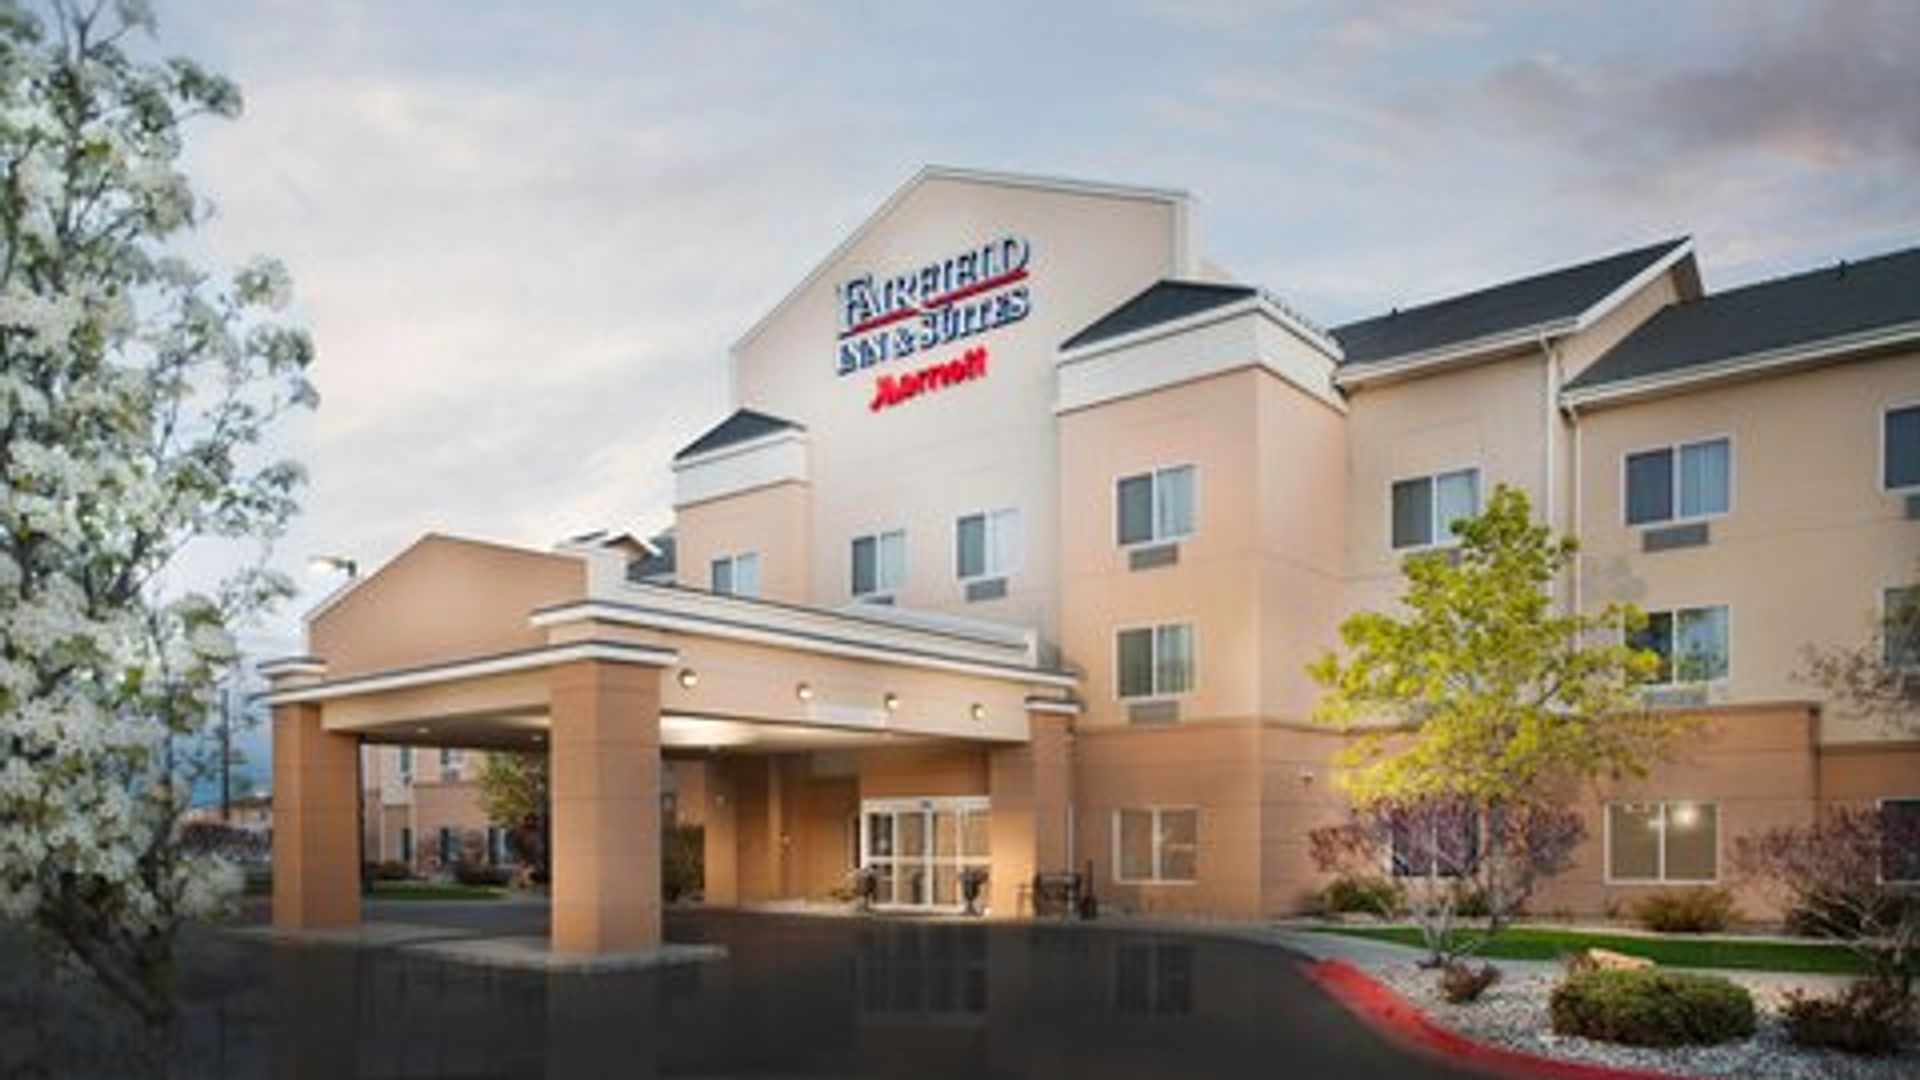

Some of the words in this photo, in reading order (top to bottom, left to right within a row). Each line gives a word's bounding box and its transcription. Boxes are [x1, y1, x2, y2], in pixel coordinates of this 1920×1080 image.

[837, 236, 1030, 339] FAIRFIELD
[893, 325, 915, 358] &
[919, 286, 1030, 350] SUITES
